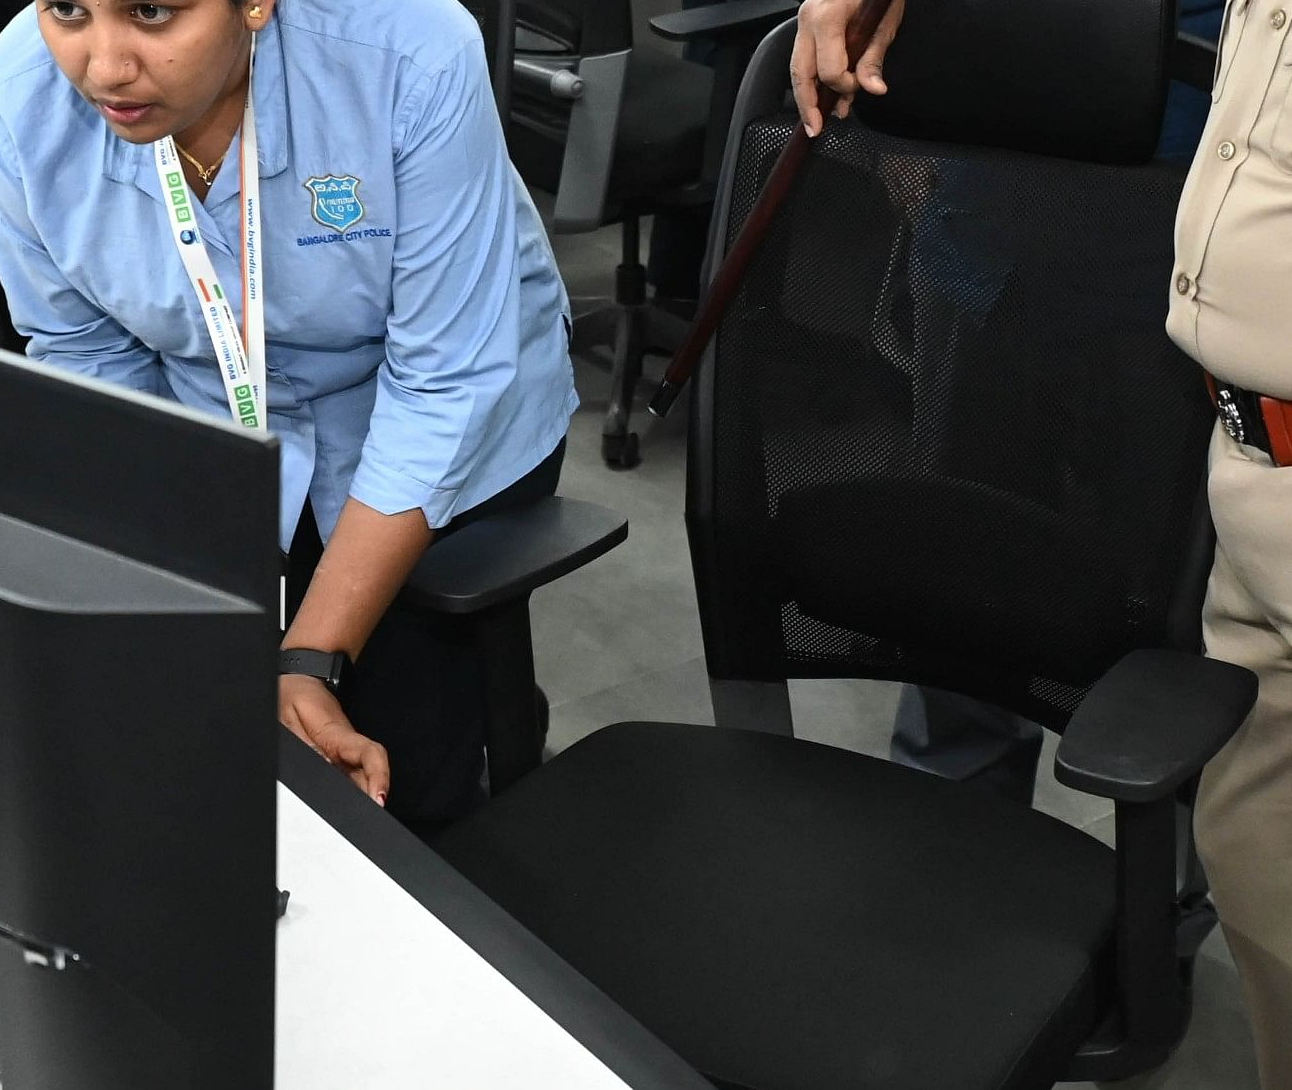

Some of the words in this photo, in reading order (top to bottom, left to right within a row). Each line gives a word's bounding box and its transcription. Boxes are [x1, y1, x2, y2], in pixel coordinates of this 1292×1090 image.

[166, 172, 191, 222] BVG
[247, 198, 257, 300] www.bvgindia.com
[297, 234, 345, 246] BANGALORE
[345, 231, 364, 242] CITY
[364, 228, 392, 238] POLICE
[210, 306, 225, 338] LIMITED
[221, 340, 231, 362] INDIA
[227, 363, 236, 380] BVG
[234, 384, 259, 428] BVG
